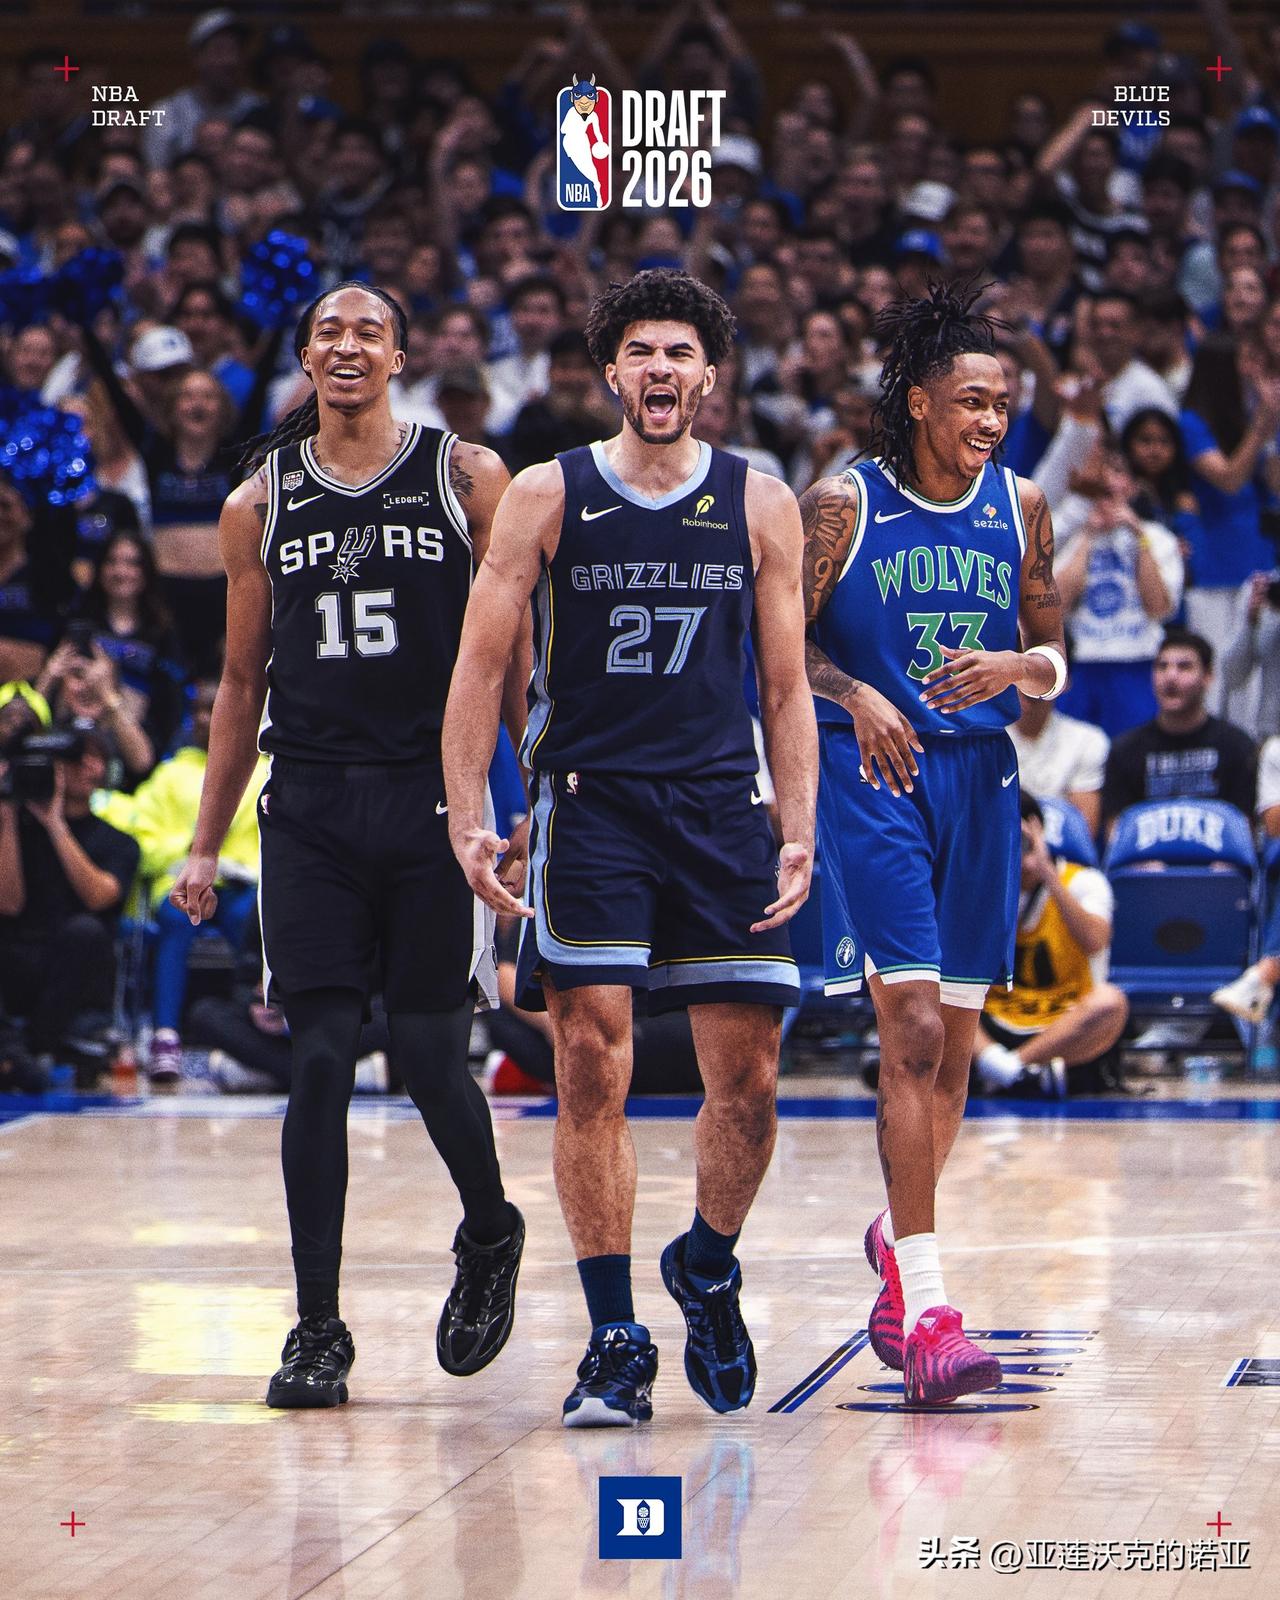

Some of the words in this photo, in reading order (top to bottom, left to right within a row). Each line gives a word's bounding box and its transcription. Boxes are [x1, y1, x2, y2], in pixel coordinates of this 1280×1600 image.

[389, 495, 424, 505] LEDGER
[682, 517, 729, 530] Robinhood
[973, 519, 1009, 531] sezzle
[571, 562, 744, 591] GRIZZLIES
[871, 545, 1013, 610] WOLVES
[315, 587, 399, 659] 15
[606, 604, 709, 675] 27
